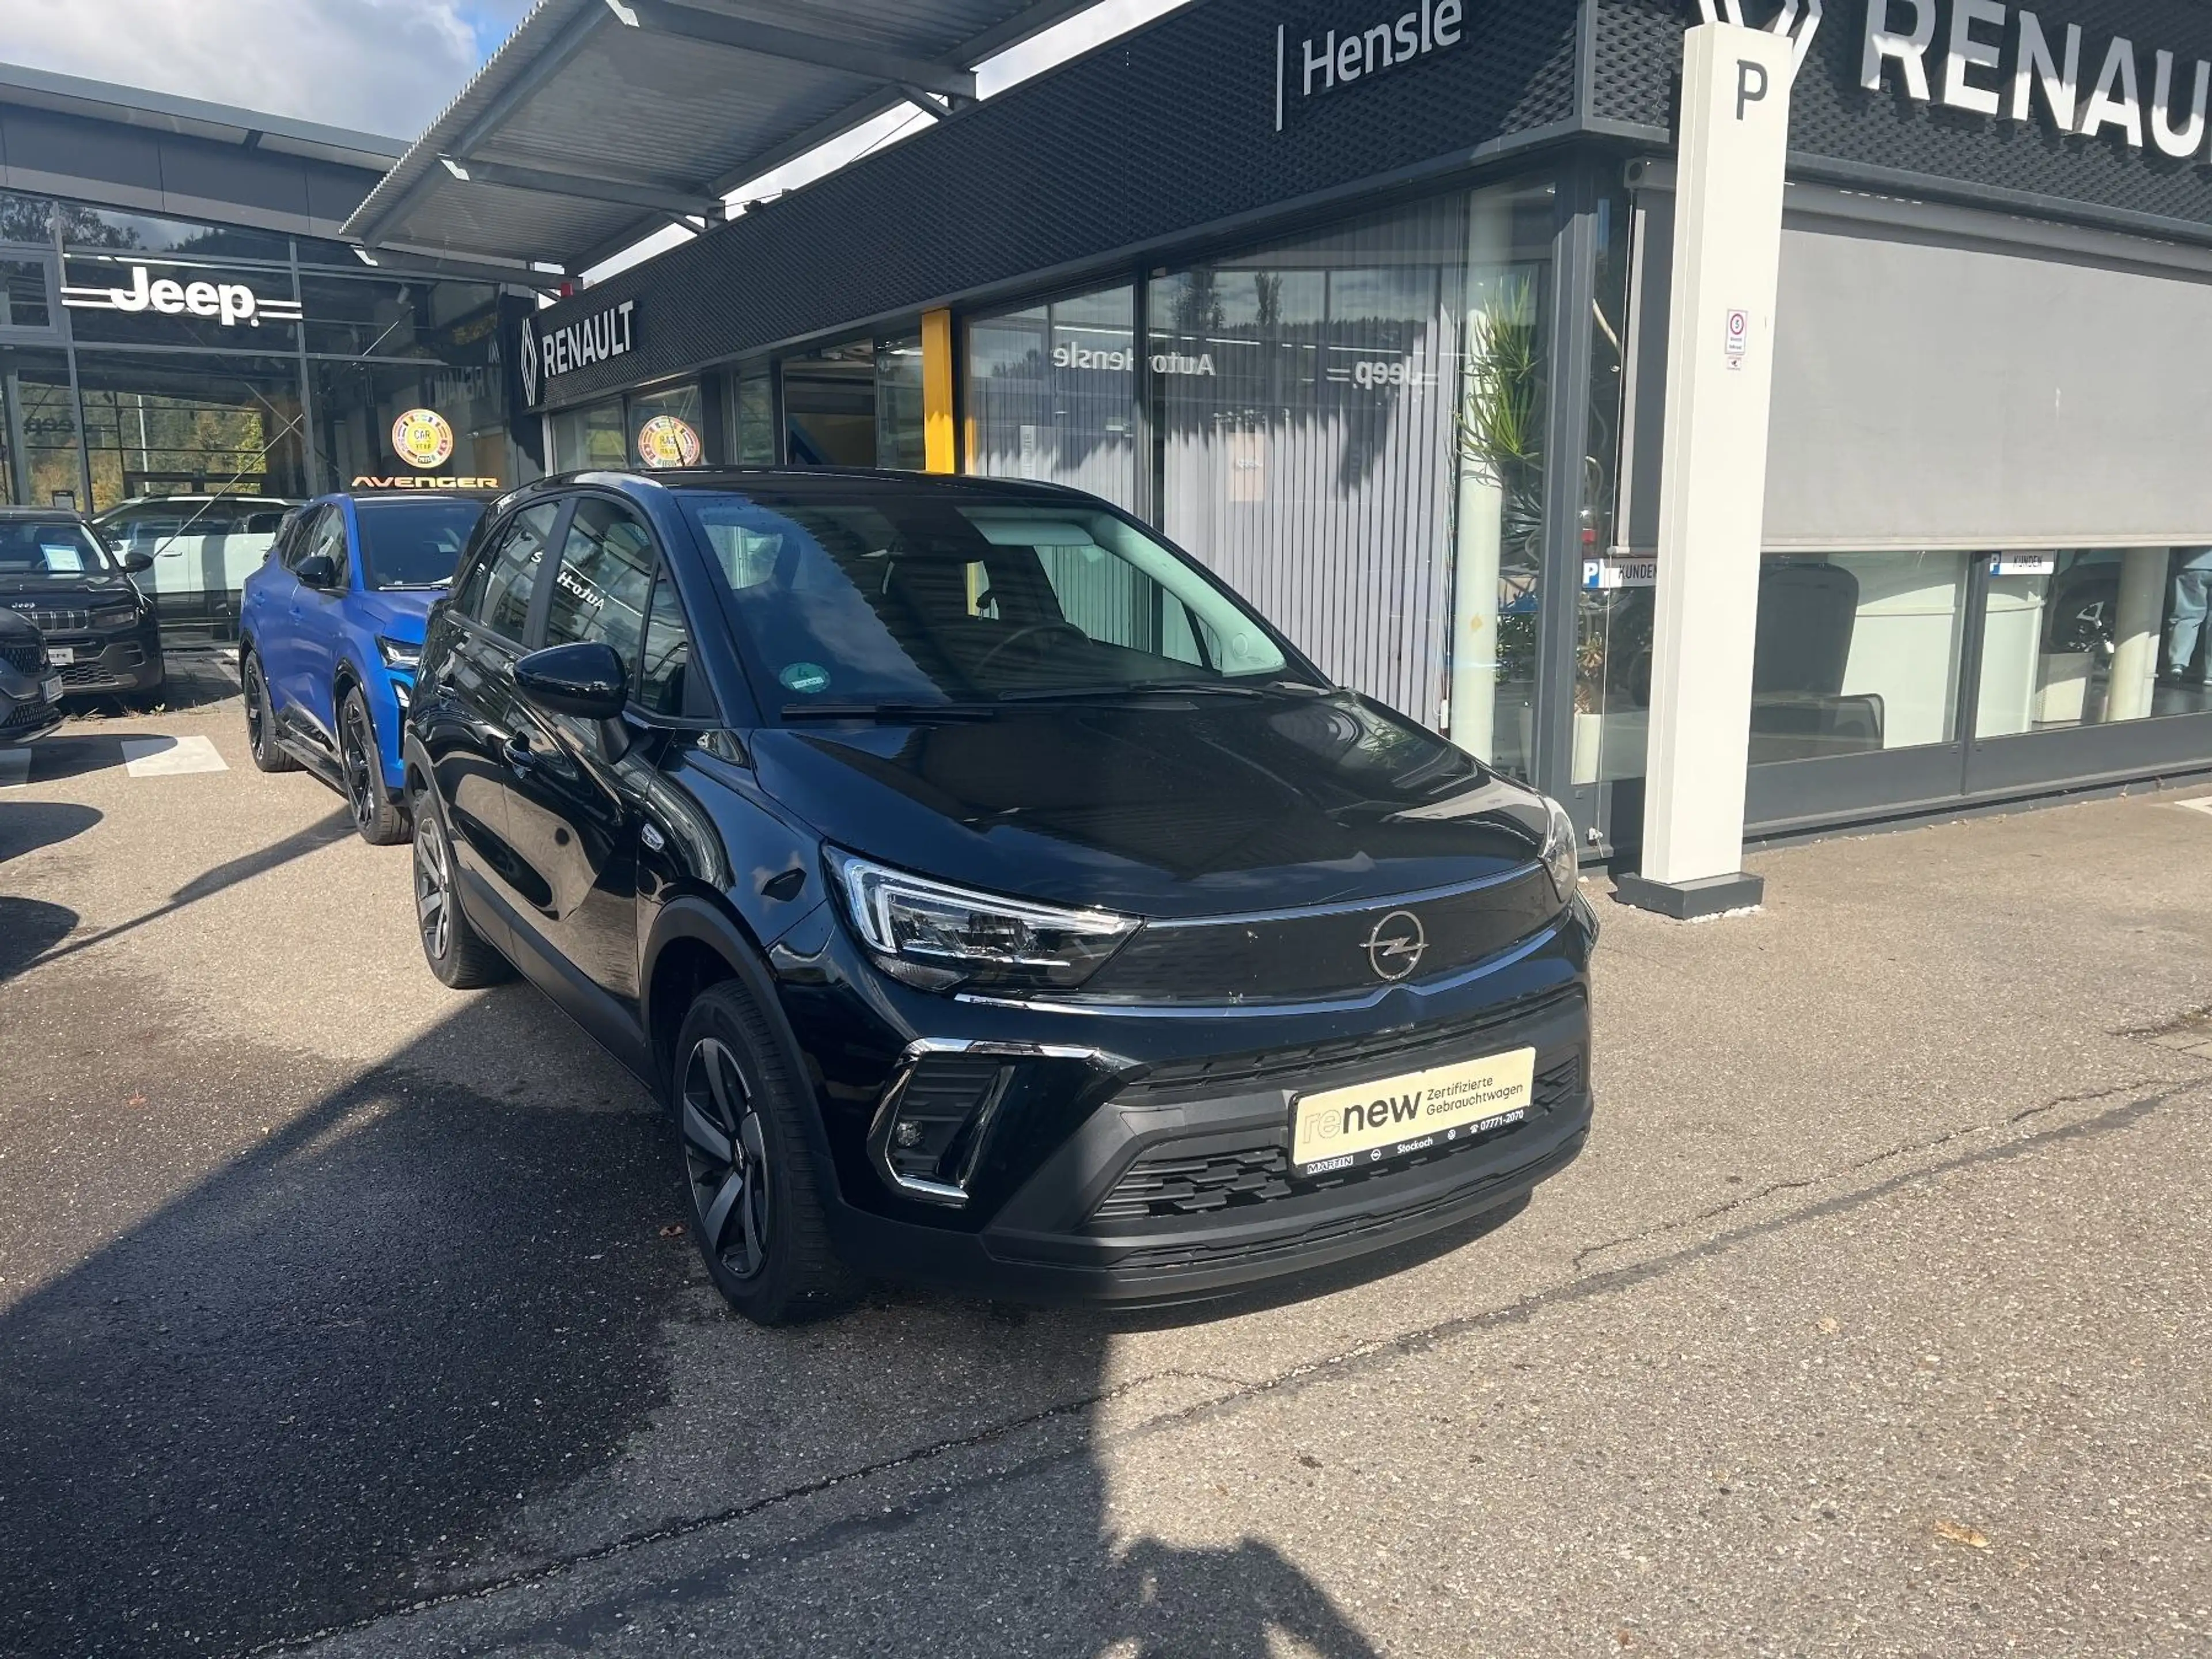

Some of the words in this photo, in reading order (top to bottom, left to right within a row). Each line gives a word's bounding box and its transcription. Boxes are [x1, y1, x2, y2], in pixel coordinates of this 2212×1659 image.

[1302, 0, 1463, 96] Hensle
[1736, 59, 1768, 120] P
[1860, 0, 2212, 158] RENAU
[111, 267, 256, 325] Jeep
[542, 300, 634, 378] RENAULT
[351, 476, 499, 488] AVENGER
[1426, 1077, 1493, 1101] Zertifizierte
[1426, 1084, 1524, 1116] Gebrauchtwagen
[1302, 1091, 1422, 1144] renew
[1306, 1155, 1354, 1174] MARTIN
